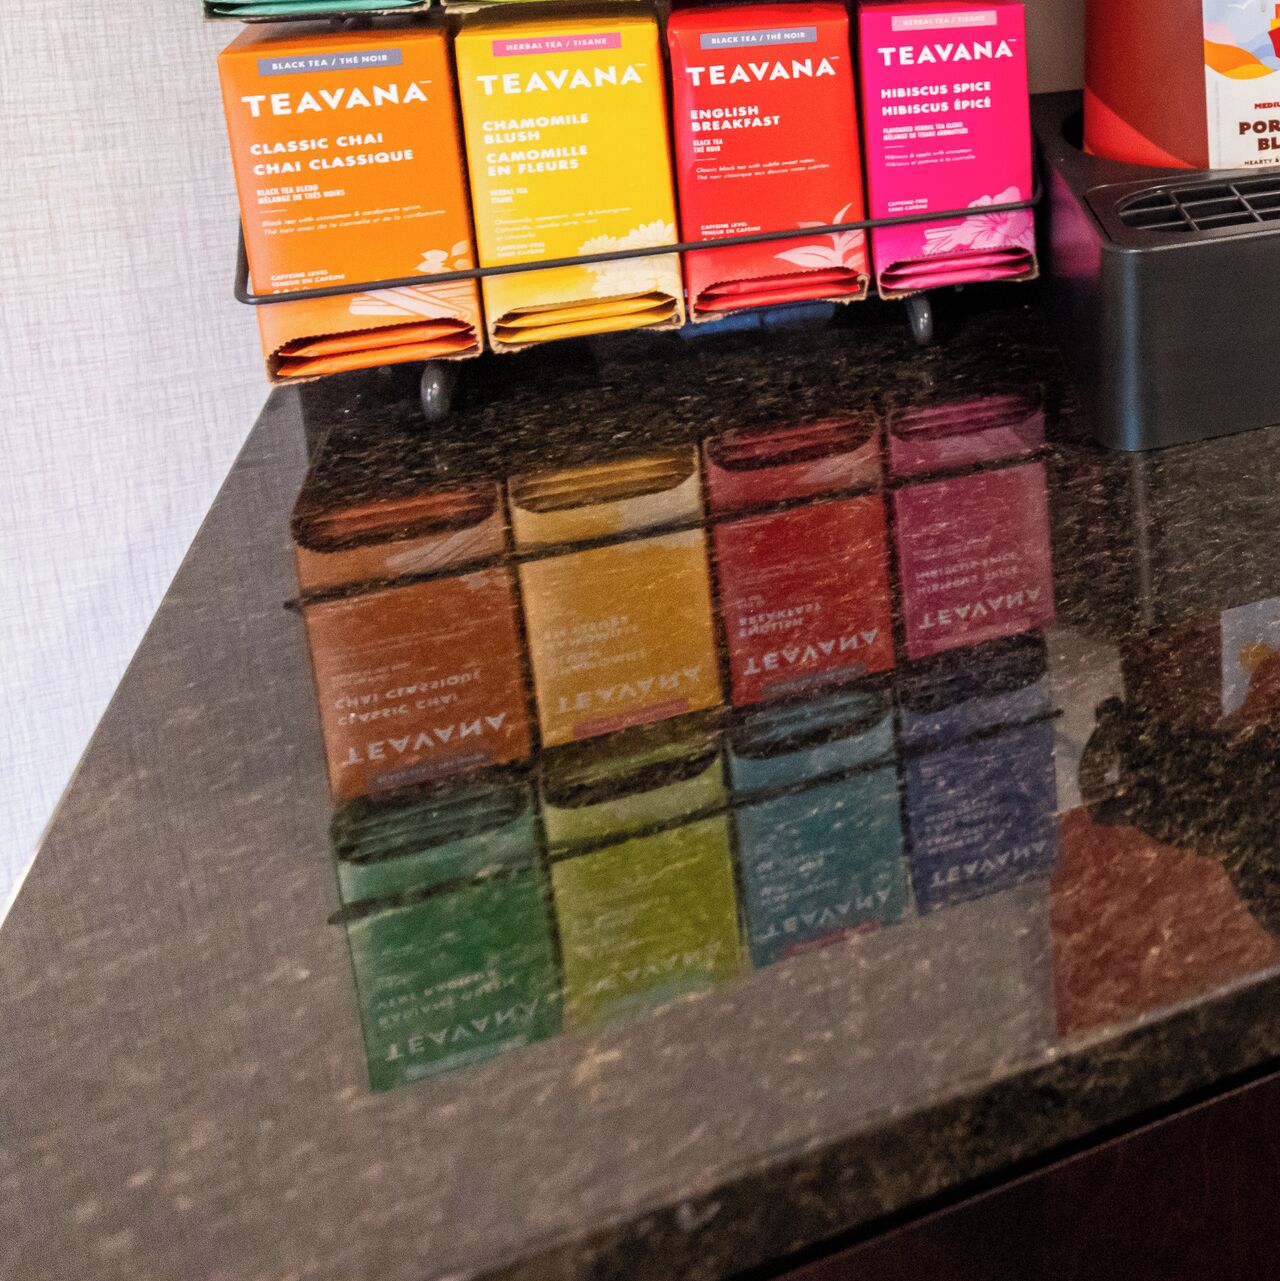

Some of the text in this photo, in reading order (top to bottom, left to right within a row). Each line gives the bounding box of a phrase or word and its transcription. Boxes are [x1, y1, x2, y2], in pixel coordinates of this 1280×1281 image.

[506, 43, 543, 51] HERBAL
[574, 38, 606, 46] TISANE
[711, 36, 738, 44] BLACK
[766, 33, 781, 41] THÉ
[272, 61, 305, 70] BLACK
[309, 59, 327, 67] TEA
[341, 56, 358, 65] THÉ
[362, 54, 387, 63] NOIR
[881, 81, 991, 98] HIBISCUS SPICE
[690, 106, 758, 120] ENGLISH
[882, 96, 991, 116] HIBISCUS ÉPICÉ
[482, 113, 588, 132] CHAMOMILE
[692, 116, 780, 131] BREAKFAST
[250, 133, 383, 155] CLASSIC CHAI
[484, 131, 540, 144] BLUSH
[253, 150, 412, 175] CHAI CLASSIQUE
[487, 145, 588, 163] CAMOMILLE
[488, 159, 579, 176] EN FLEURS
